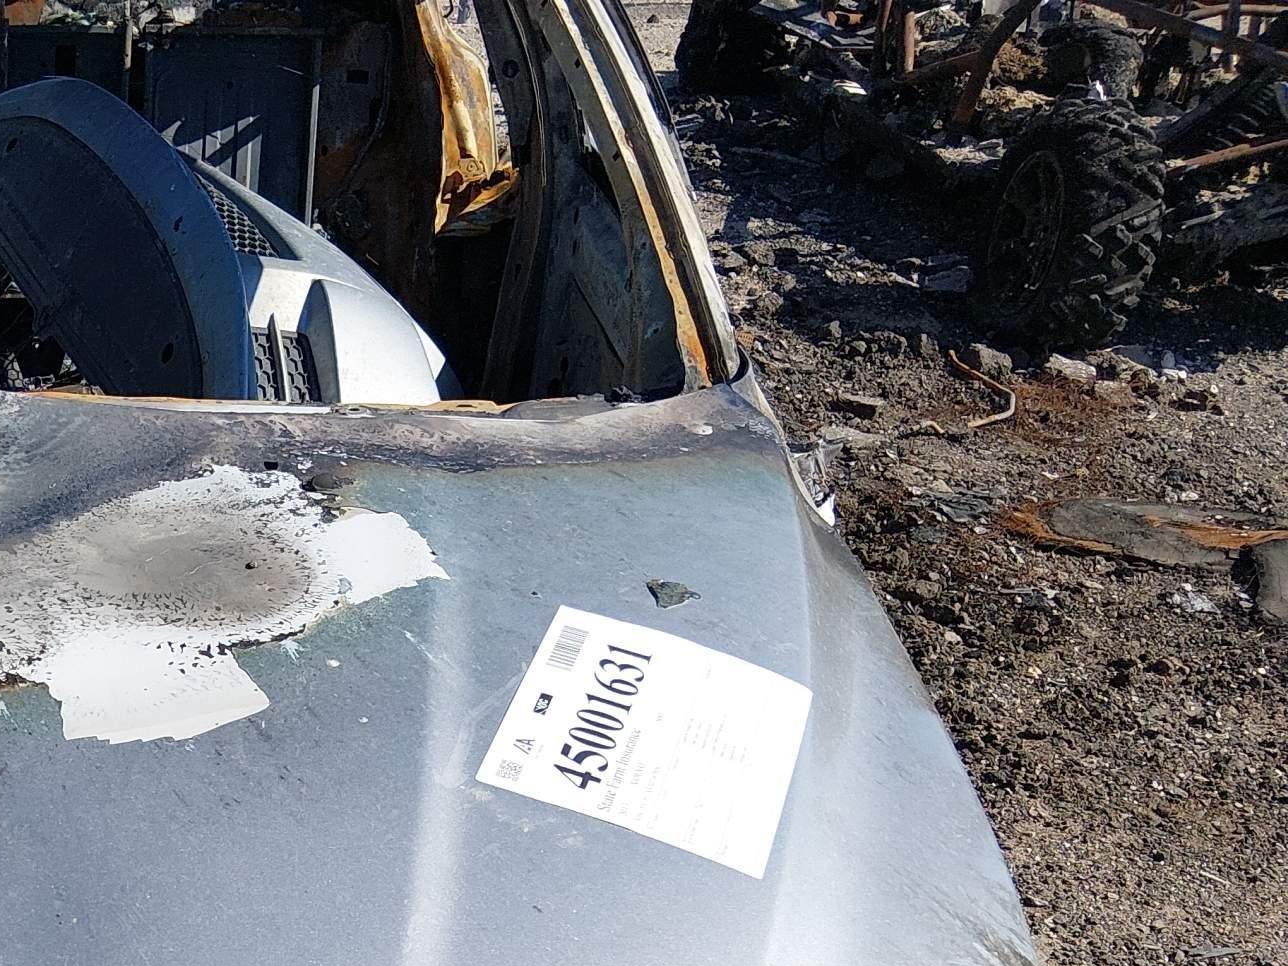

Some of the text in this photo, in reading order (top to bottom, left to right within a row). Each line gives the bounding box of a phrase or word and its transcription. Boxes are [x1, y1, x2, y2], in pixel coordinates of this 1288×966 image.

[553, 644, 653, 790] 45001631
[615, 727, 641, 766] Insurance
[605, 767, 626, 789] Farm
[596, 790, 617, 812] State
